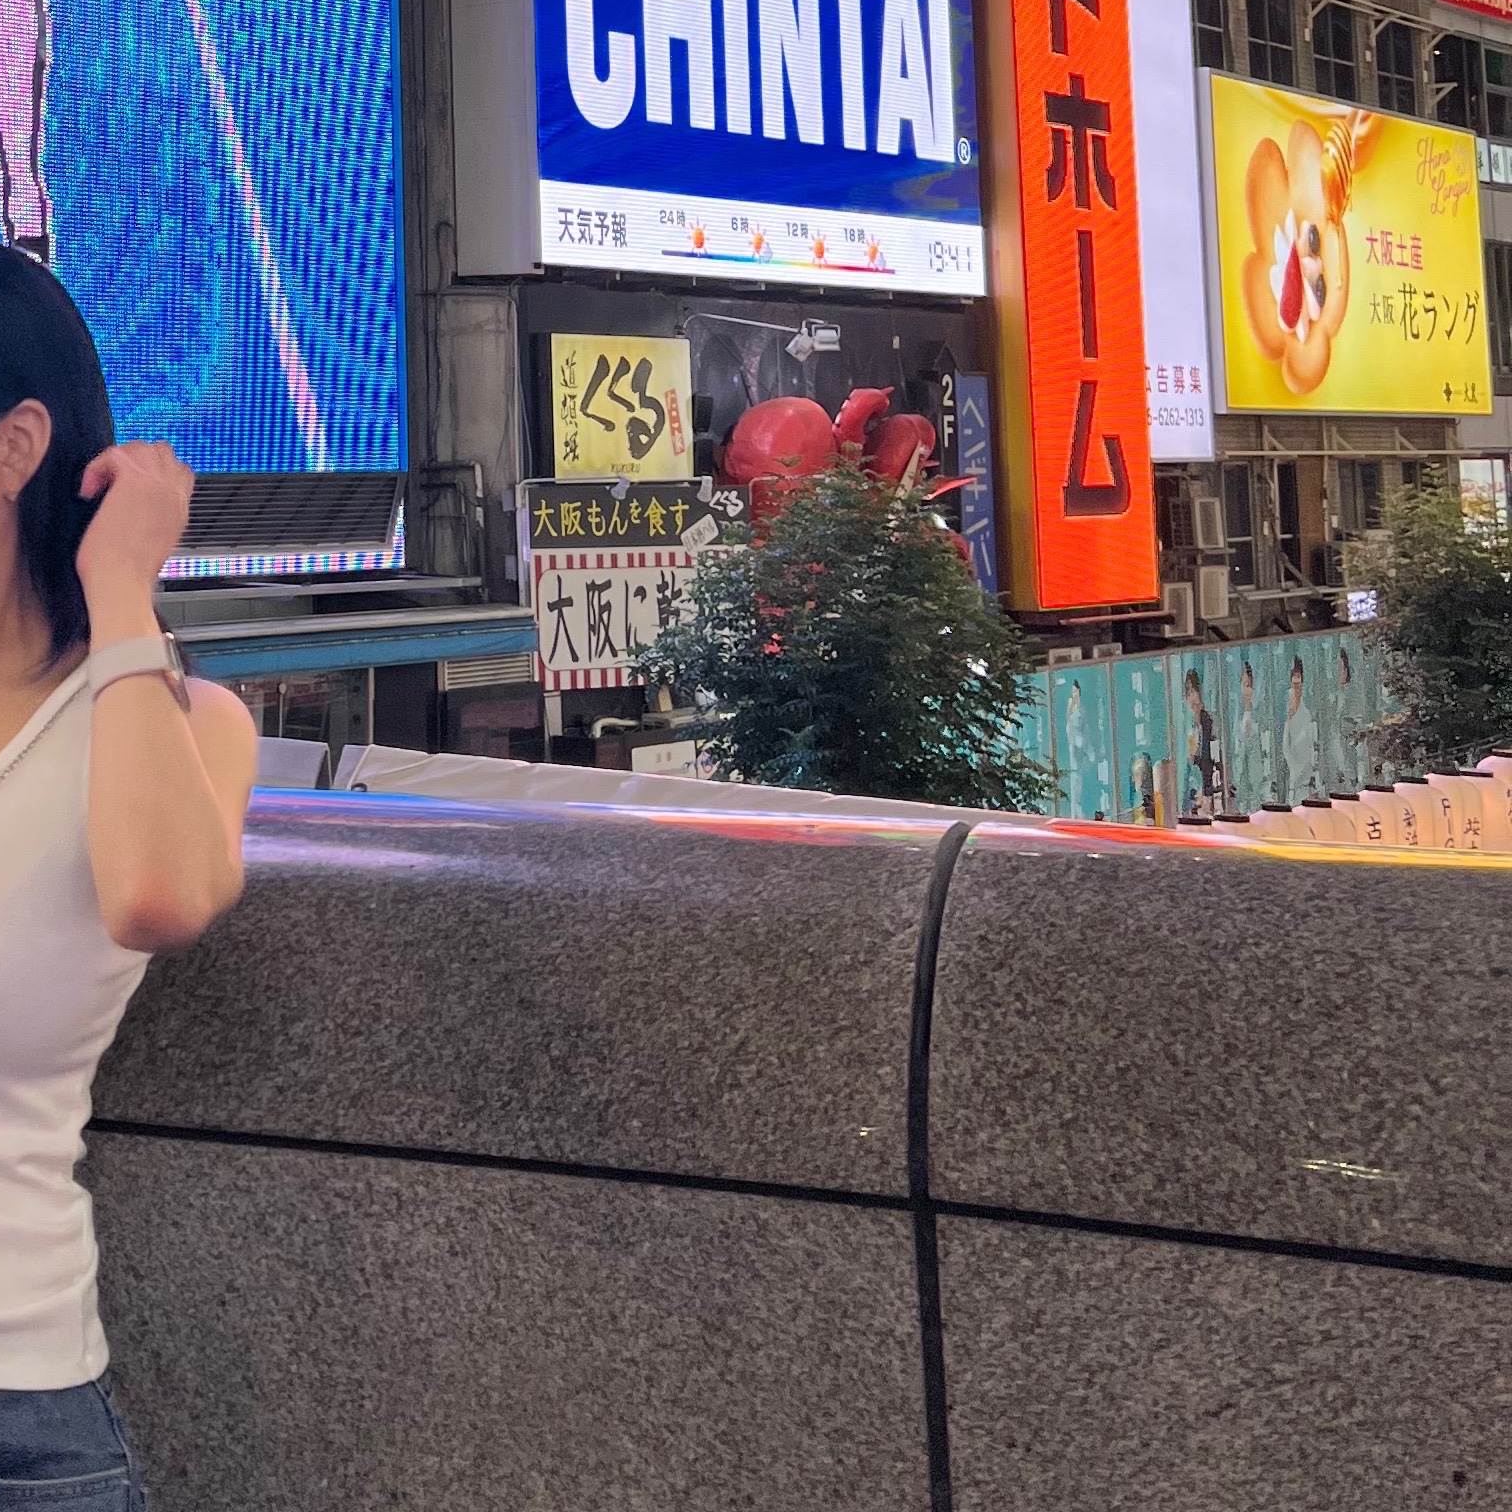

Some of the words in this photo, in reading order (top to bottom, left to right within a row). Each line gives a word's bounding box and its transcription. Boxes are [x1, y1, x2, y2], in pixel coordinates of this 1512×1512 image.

[557, 207, 628, 247] 天気予報
[928, 241, 972, 273] 19:41
[1366, 227, 1424, 271] 大阪土産
[579, 354, 665, 460] くくる
[533, 496, 690, 537] 大阪もんを食す
